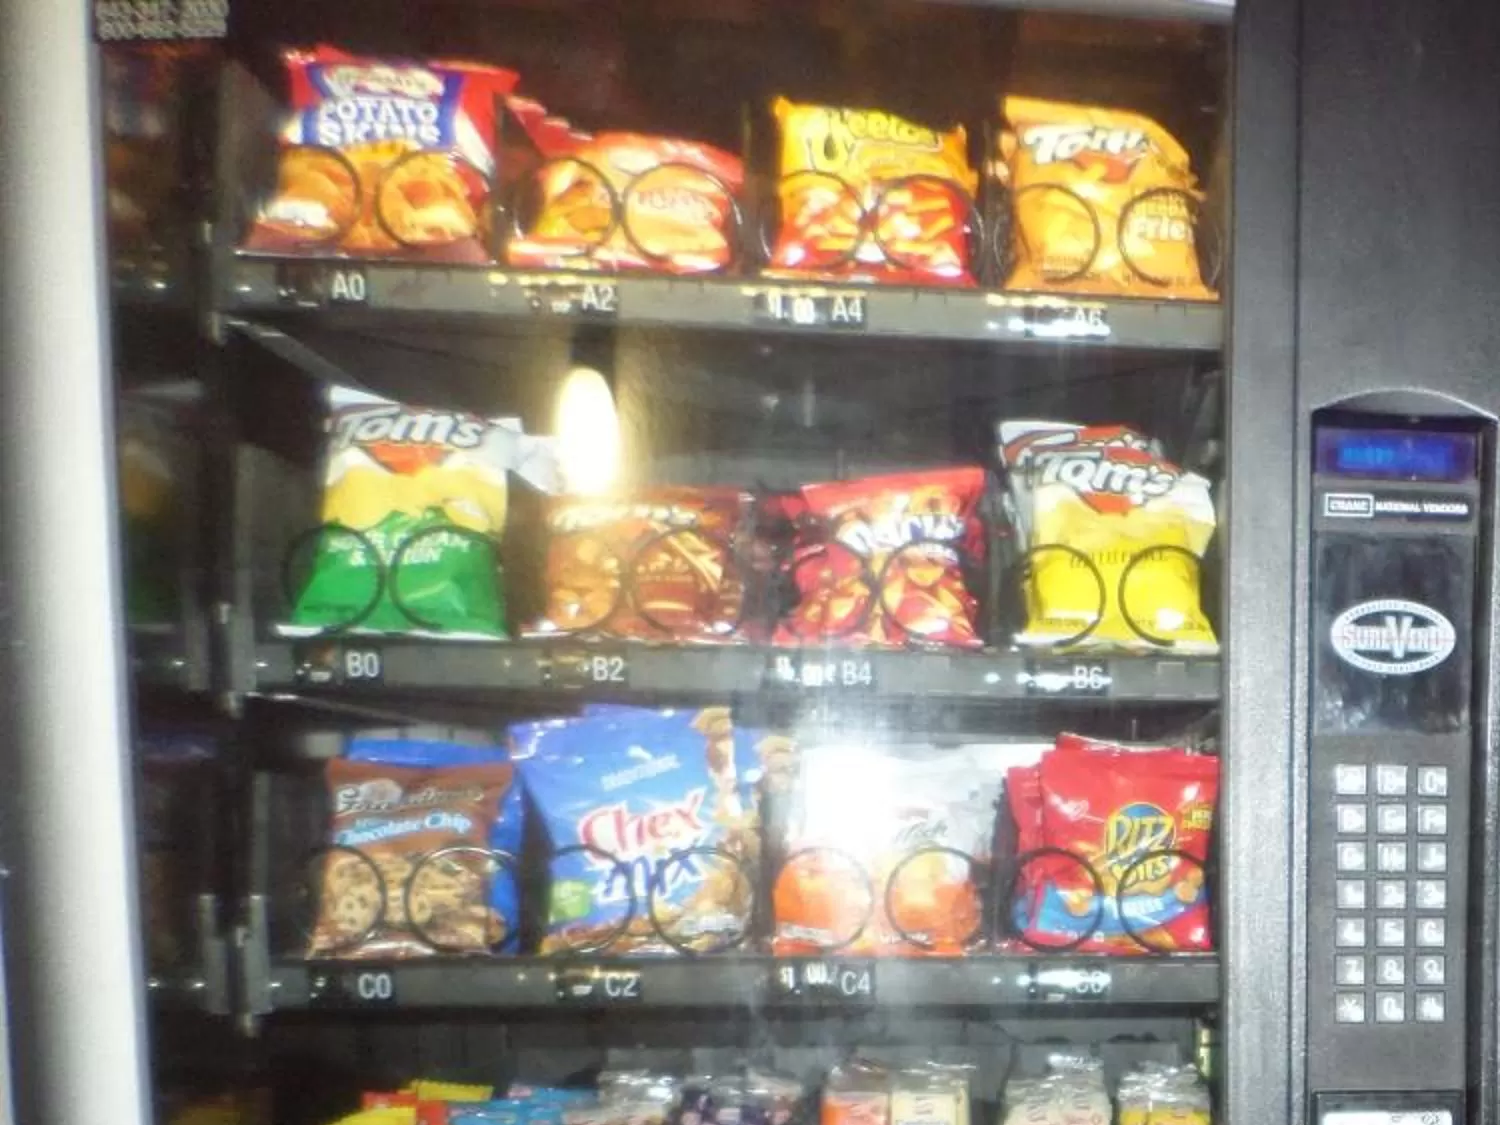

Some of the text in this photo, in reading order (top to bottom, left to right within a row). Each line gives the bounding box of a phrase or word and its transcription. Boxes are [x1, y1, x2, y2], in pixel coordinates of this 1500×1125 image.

[317, 99, 438, 123] POTATO
[331, 275, 366, 301] A0
[581, 286, 616, 313] A2
[832, 297, 863, 323] A4
[340, 408, 487, 449] Tom's
[1035, 451, 1175, 497] Tom's
[346, 652, 379, 678] B0
[591, 656, 625, 683] B2
[842, 660, 872, 686] B4
[580, 788, 706, 864] Chex
[357, 973, 393, 998] C0
[604, 973, 638, 998] C2
[841, 970, 871, 996] C4
